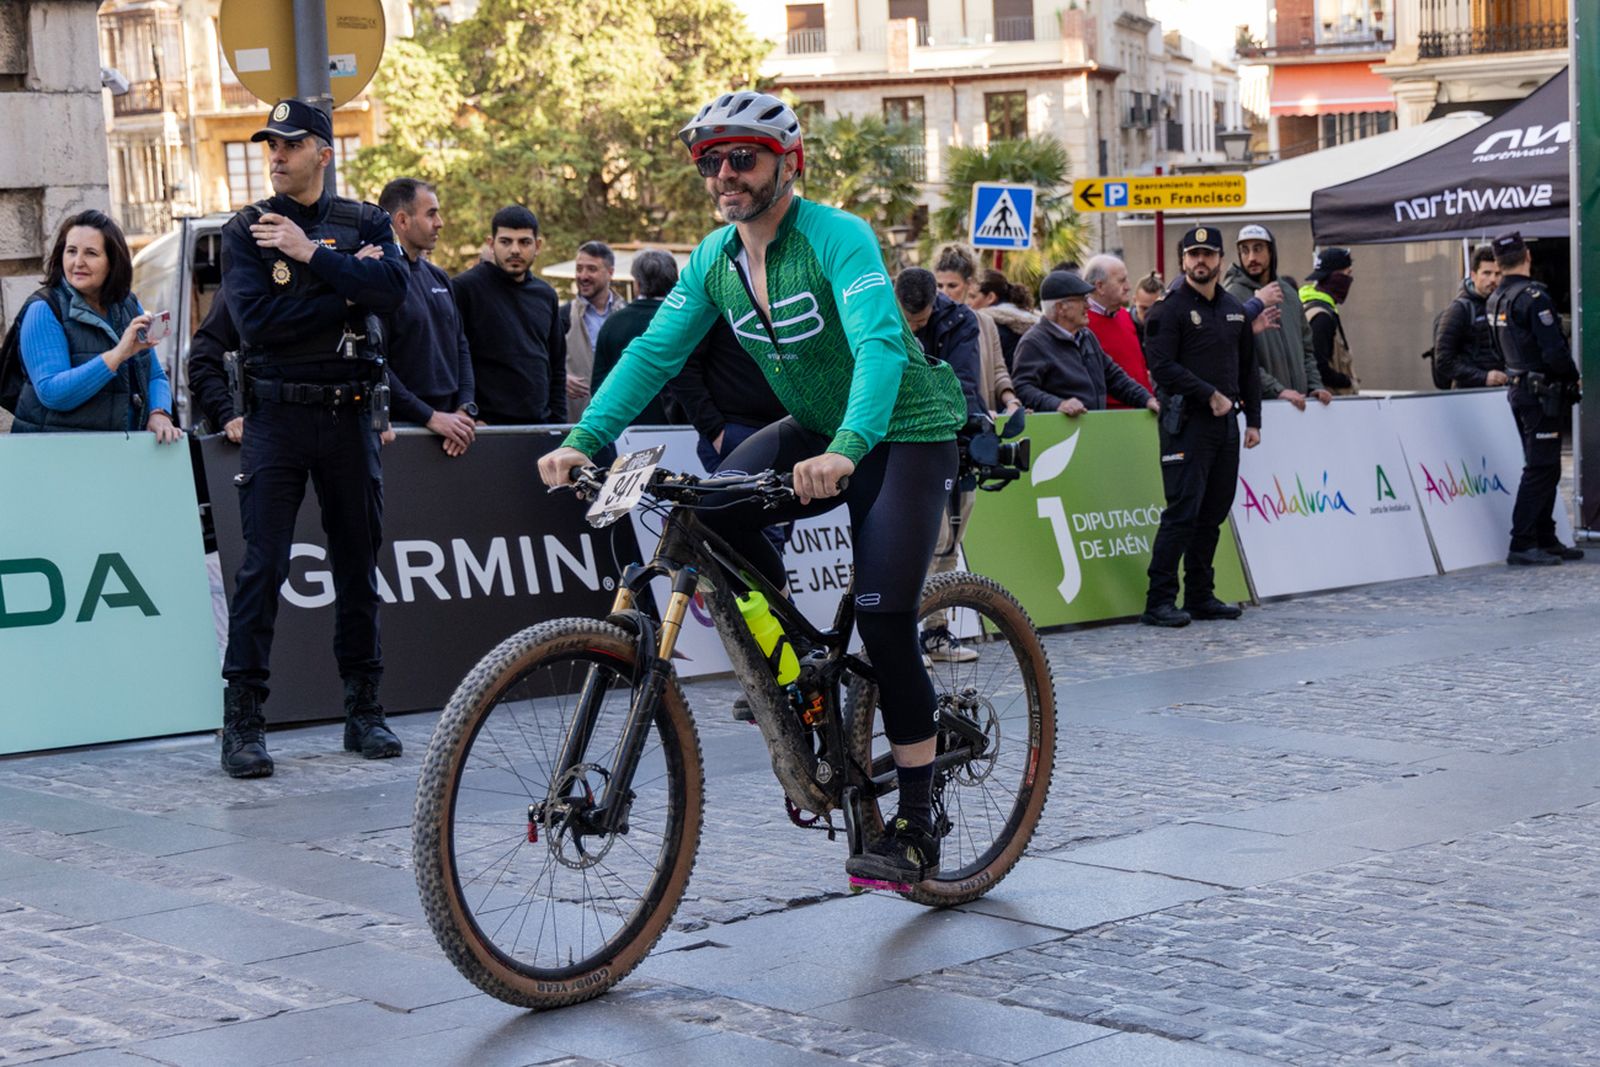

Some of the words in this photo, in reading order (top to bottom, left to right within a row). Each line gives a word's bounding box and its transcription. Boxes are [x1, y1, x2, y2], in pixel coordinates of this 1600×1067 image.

[1198, 180, 1241, 189] municipal
[1133, 194, 1161, 205] San
[1171, 192, 1242, 205] Francisco
[1072, 503, 1167, 532] DIPUTACIÓ
[784, 525, 852, 555] UNTA
[1080, 540, 1107, 560] DE
[1108, 533, 1150, 557] JAÉN
